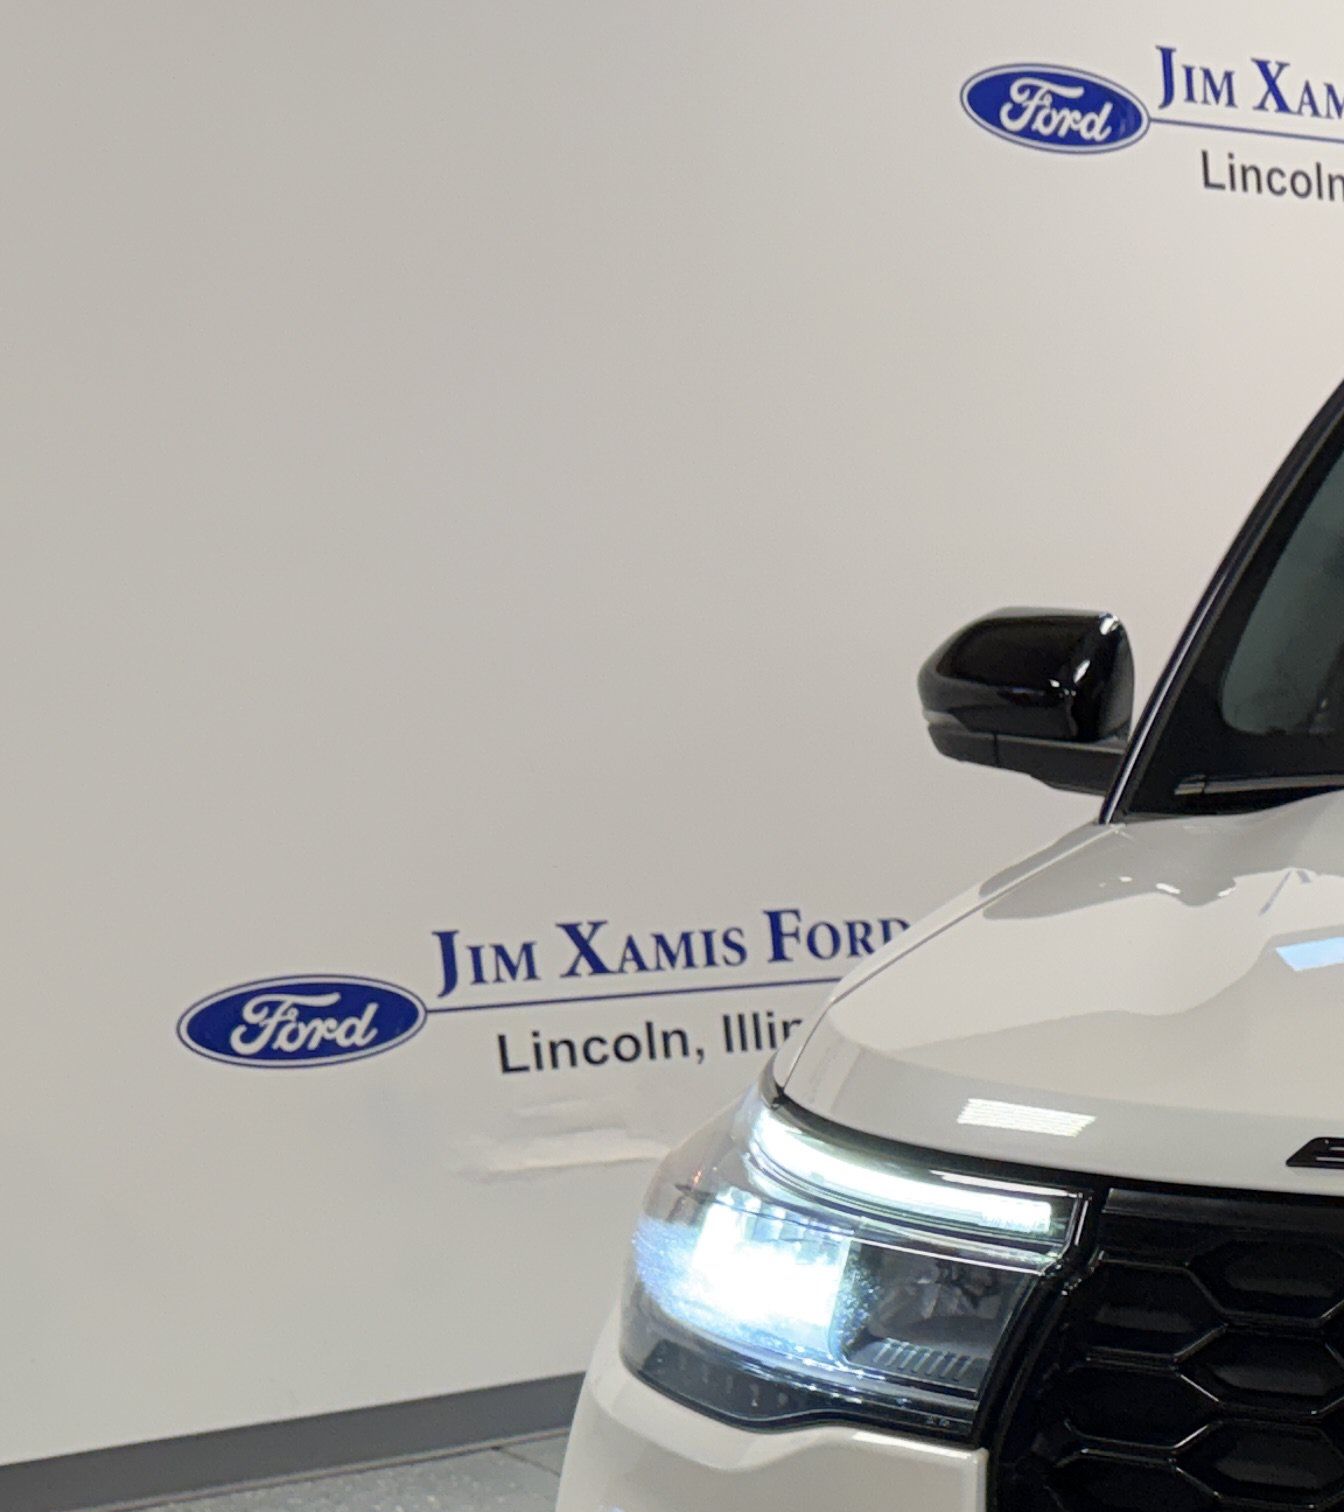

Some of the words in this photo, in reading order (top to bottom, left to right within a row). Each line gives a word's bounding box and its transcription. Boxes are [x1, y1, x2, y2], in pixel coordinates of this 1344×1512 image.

[1155, 45, 1237, 110] JIM
[1000, 77, 1114, 144] Ford
[431, 929, 540, 998] JIM
[555, 920, 748, 980] XAMIS
[230, 991, 378, 1055] Ford
[498, 1021, 705, 1075] Lincoln,
